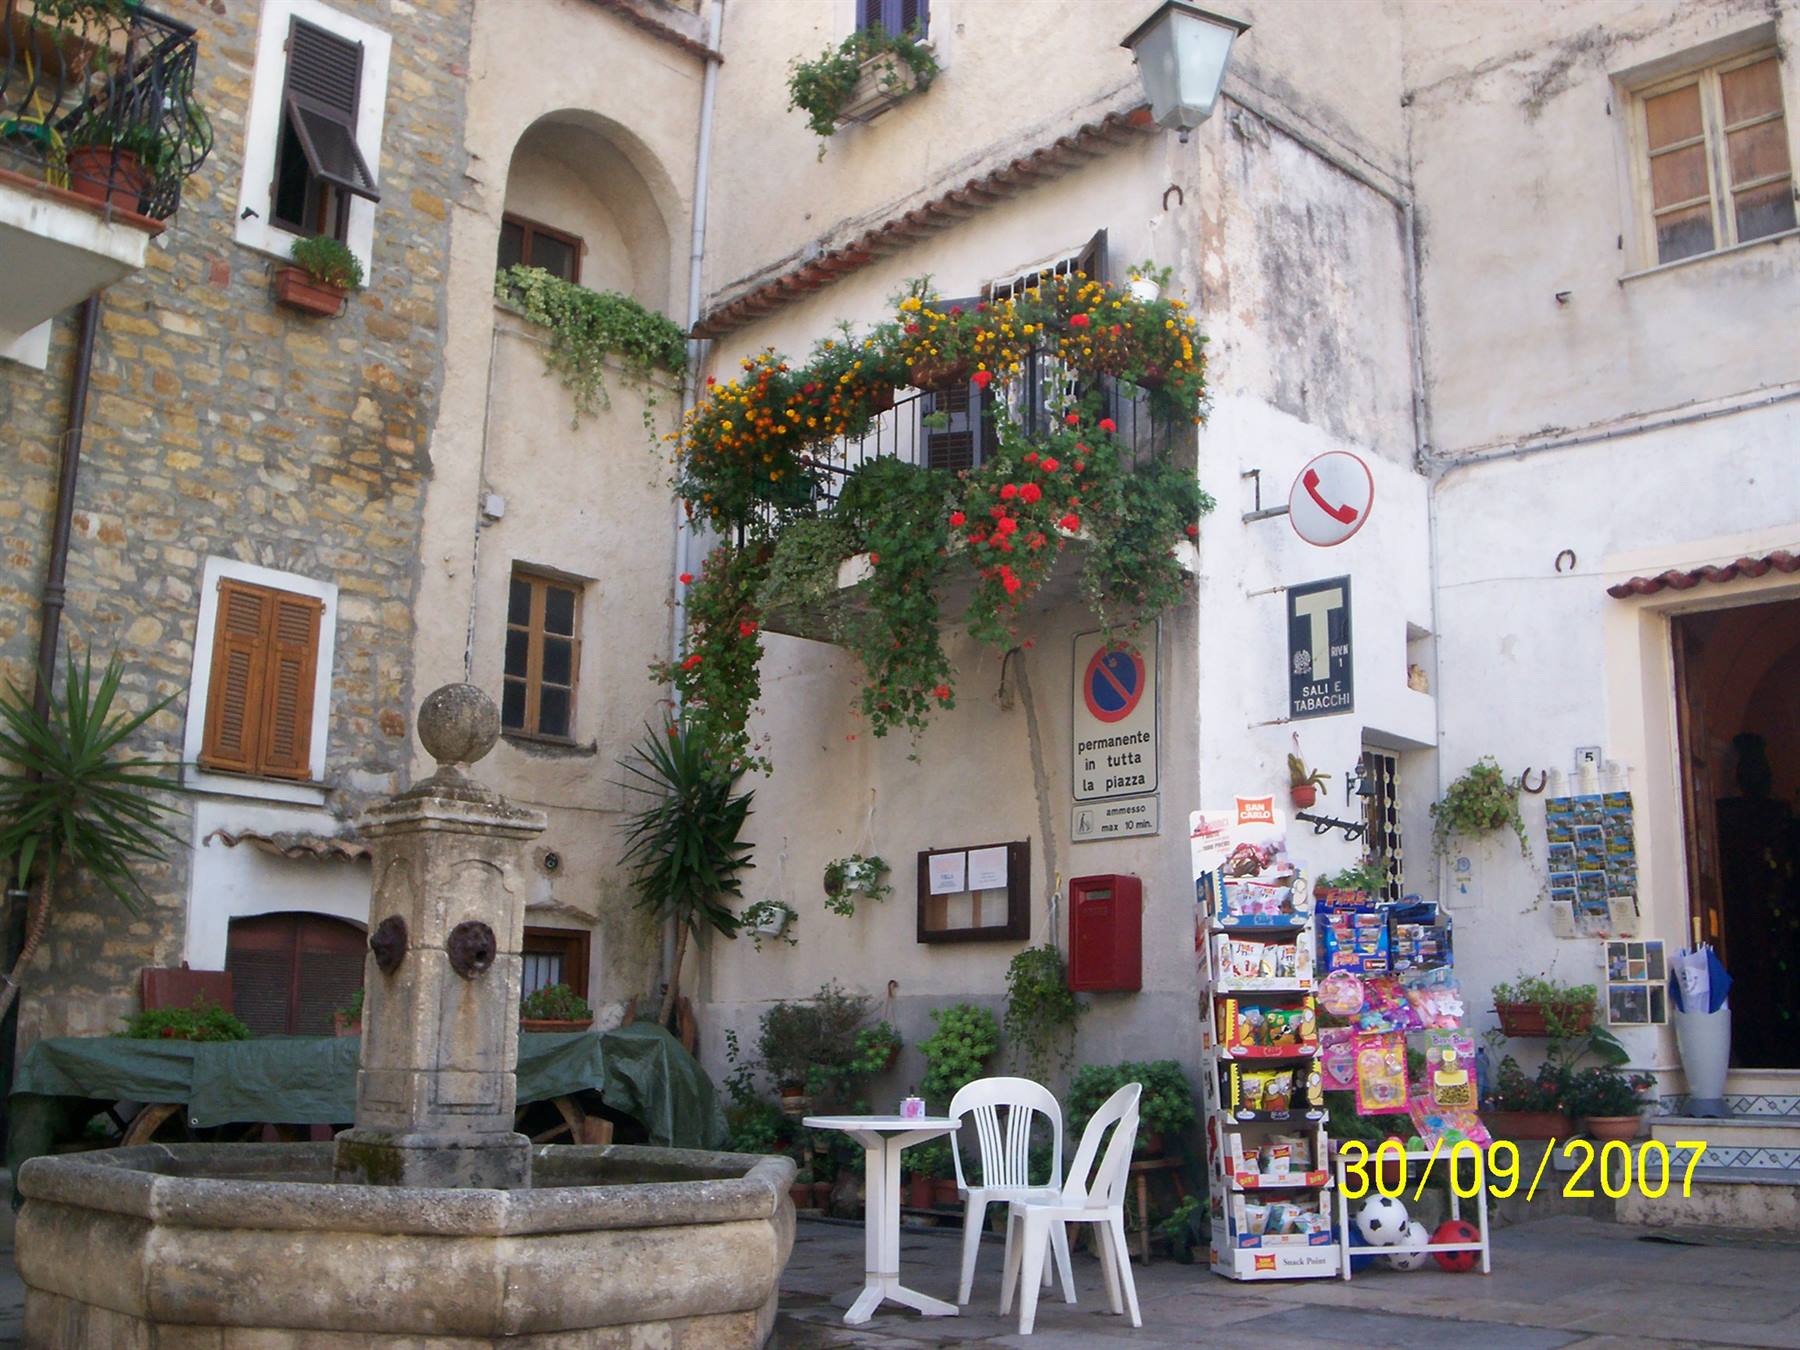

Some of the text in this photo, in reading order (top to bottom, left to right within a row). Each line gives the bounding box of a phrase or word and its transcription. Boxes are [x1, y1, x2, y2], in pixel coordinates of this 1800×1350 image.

[1295, 587, 1343, 681] T
[1302, 681, 1341, 697] SALI E
[1294, 693, 1350, 712] TABACCHI
[1078, 731, 1150, 755] permanente
[1084, 752, 1142, 771] in tutta
[1585, 751, 1594, 763] 5
[1082, 774, 1146, 792] la piazza
[1106, 805, 1146, 816] ammesso
[1245, 803, 1265, 811] SAN
[1240, 811, 1271, 819] CARLO
[1101, 819, 1153, 832] max 10 min.
[1283, 1258, 1304, 1266] Snack
[1306, 1257, 1326, 1265] Point
